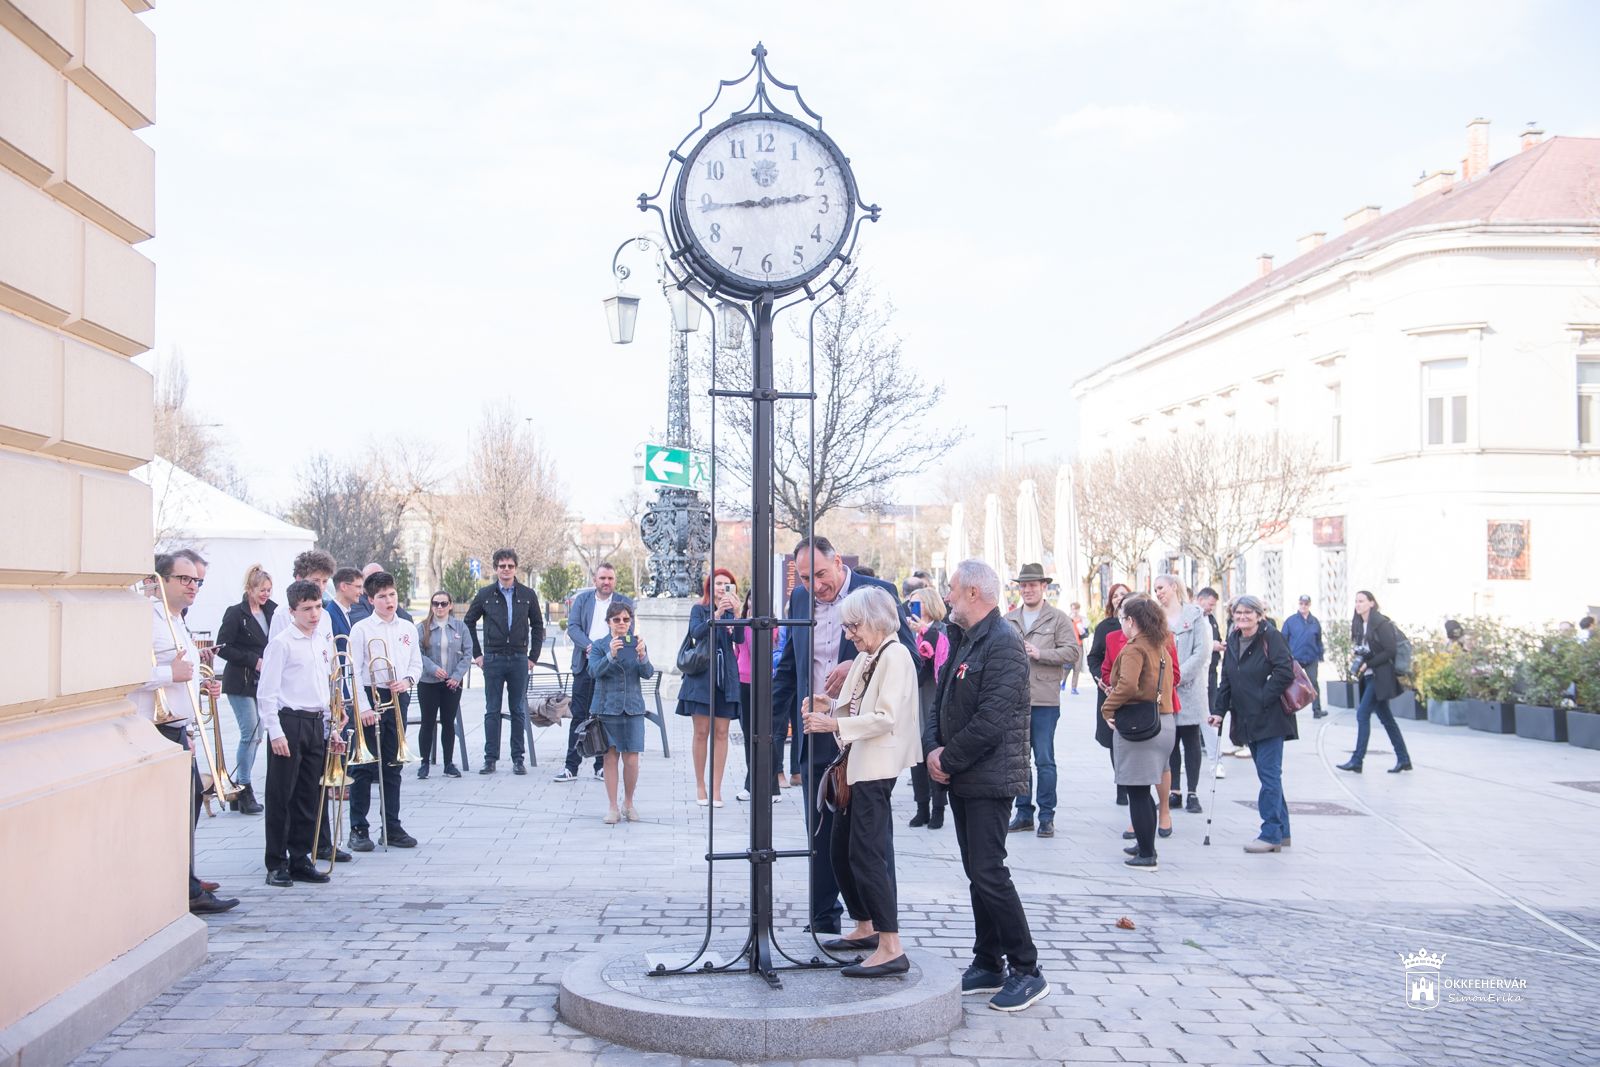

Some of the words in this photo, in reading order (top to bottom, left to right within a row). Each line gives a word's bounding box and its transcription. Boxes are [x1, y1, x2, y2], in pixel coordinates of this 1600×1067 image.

[729, 139, 747, 159] 11
[755, 132, 776, 153] 12
[790, 141, 799, 160] 1
[705, 160, 725, 181] 10
[814, 166, 826, 186] 2
[701, 193, 713, 213] 9
[818, 194, 829, 214] 3
[710, 222, 721, 243] 8
[810, 223, 821, 243] 4
[732, 246, 743, 265] 7
[761, 253, 773, 273] 6
[792, 245, 804, 265] 5
